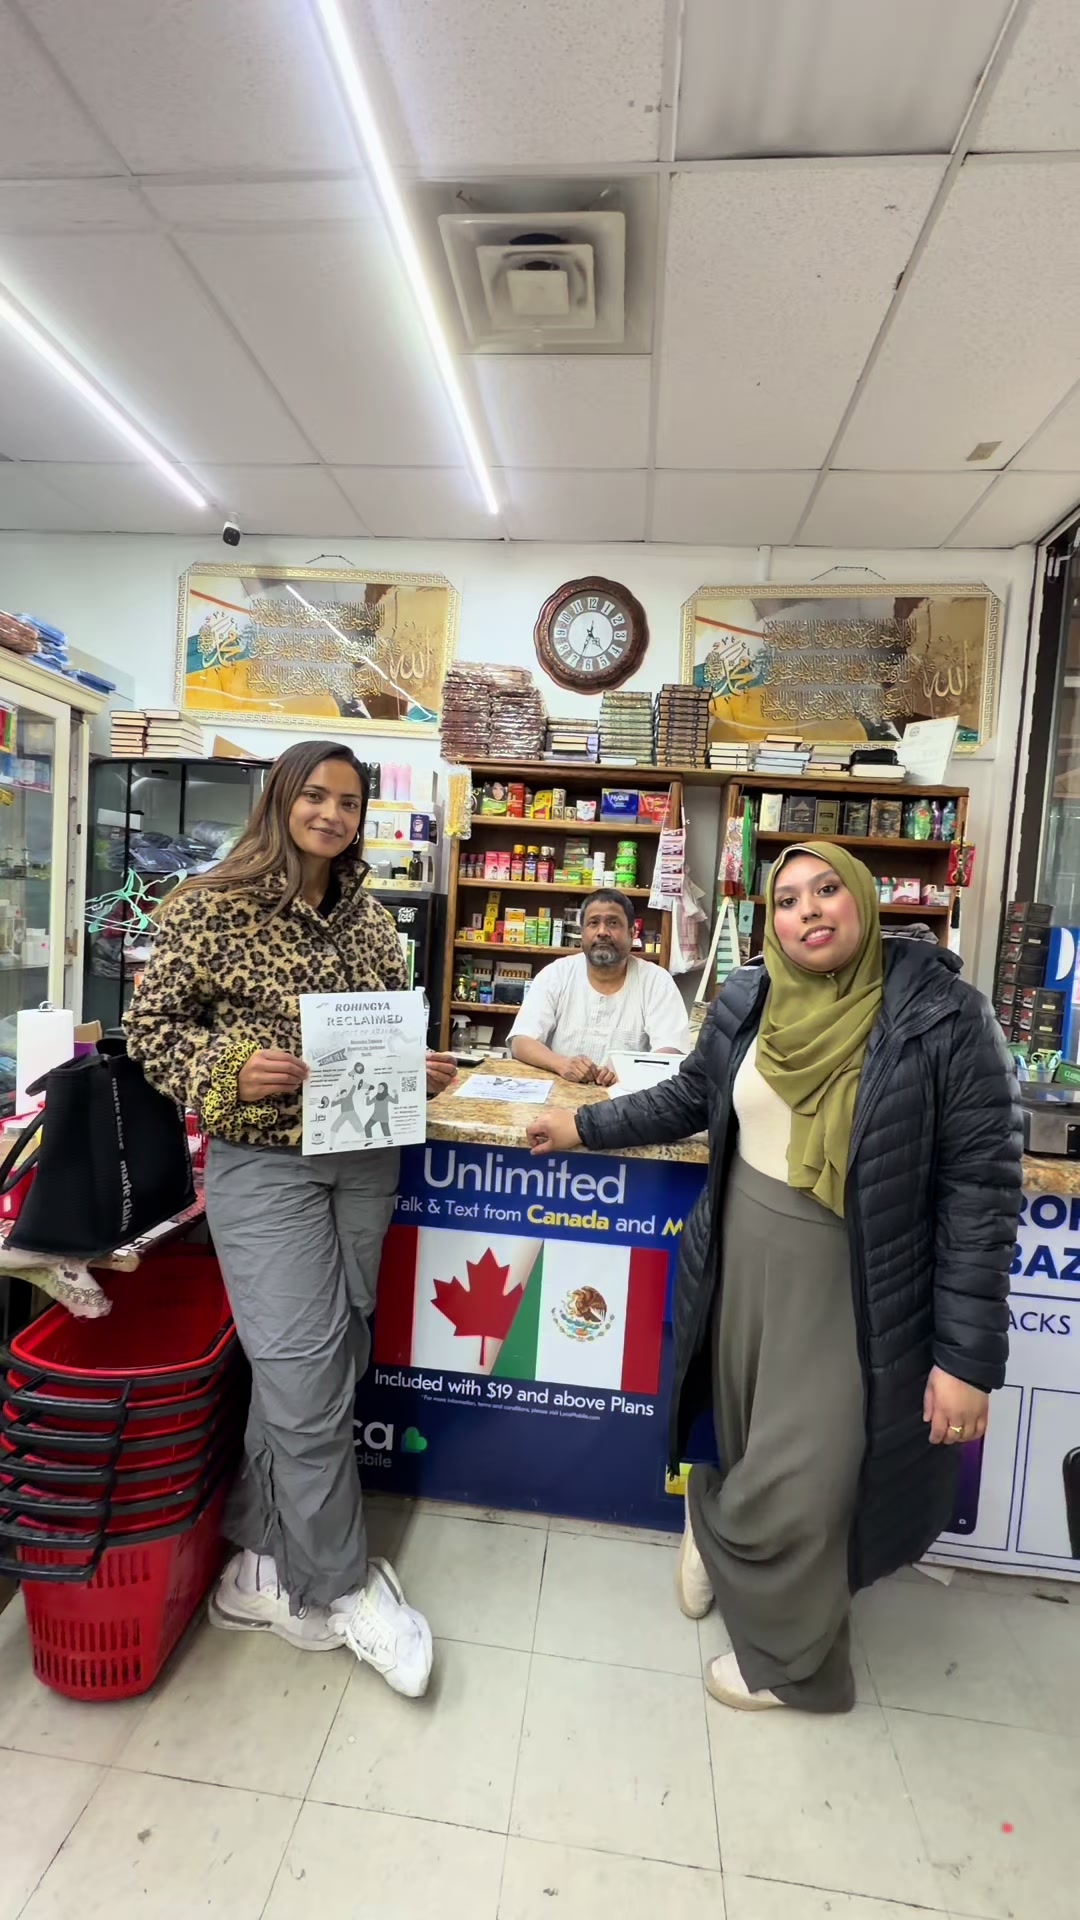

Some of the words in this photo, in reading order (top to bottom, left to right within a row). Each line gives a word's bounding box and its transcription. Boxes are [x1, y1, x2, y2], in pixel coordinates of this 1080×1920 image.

[327, 1014, 403, 1026] RECLAIMED
[335, 1002, 391, 1012] ROHINGYA
[120, 1160, 133, 1197] marie
[423, 1147, 627, 1204] Unlimited
[119, 1197, 133, 1233] claire
[394, 1195, 423, 1212] Talk
[427, 1198, 441, 1214] &
[445, 1200, 480, 1218] Text
[484, 1203, 521, 1222] from
[526, 1204, 609, 1230] Canada
[615, 1215, 656, 1235] and
[375, 1368, 443, 1392] Included
[448, 1378, 481, 1396] with
[486, 1381, 513, 1400] $19
[517, 1388, 549, 1404] and
[553, 1390, 606, 1410] above
[611, 1396, 654, 1416] Plans
